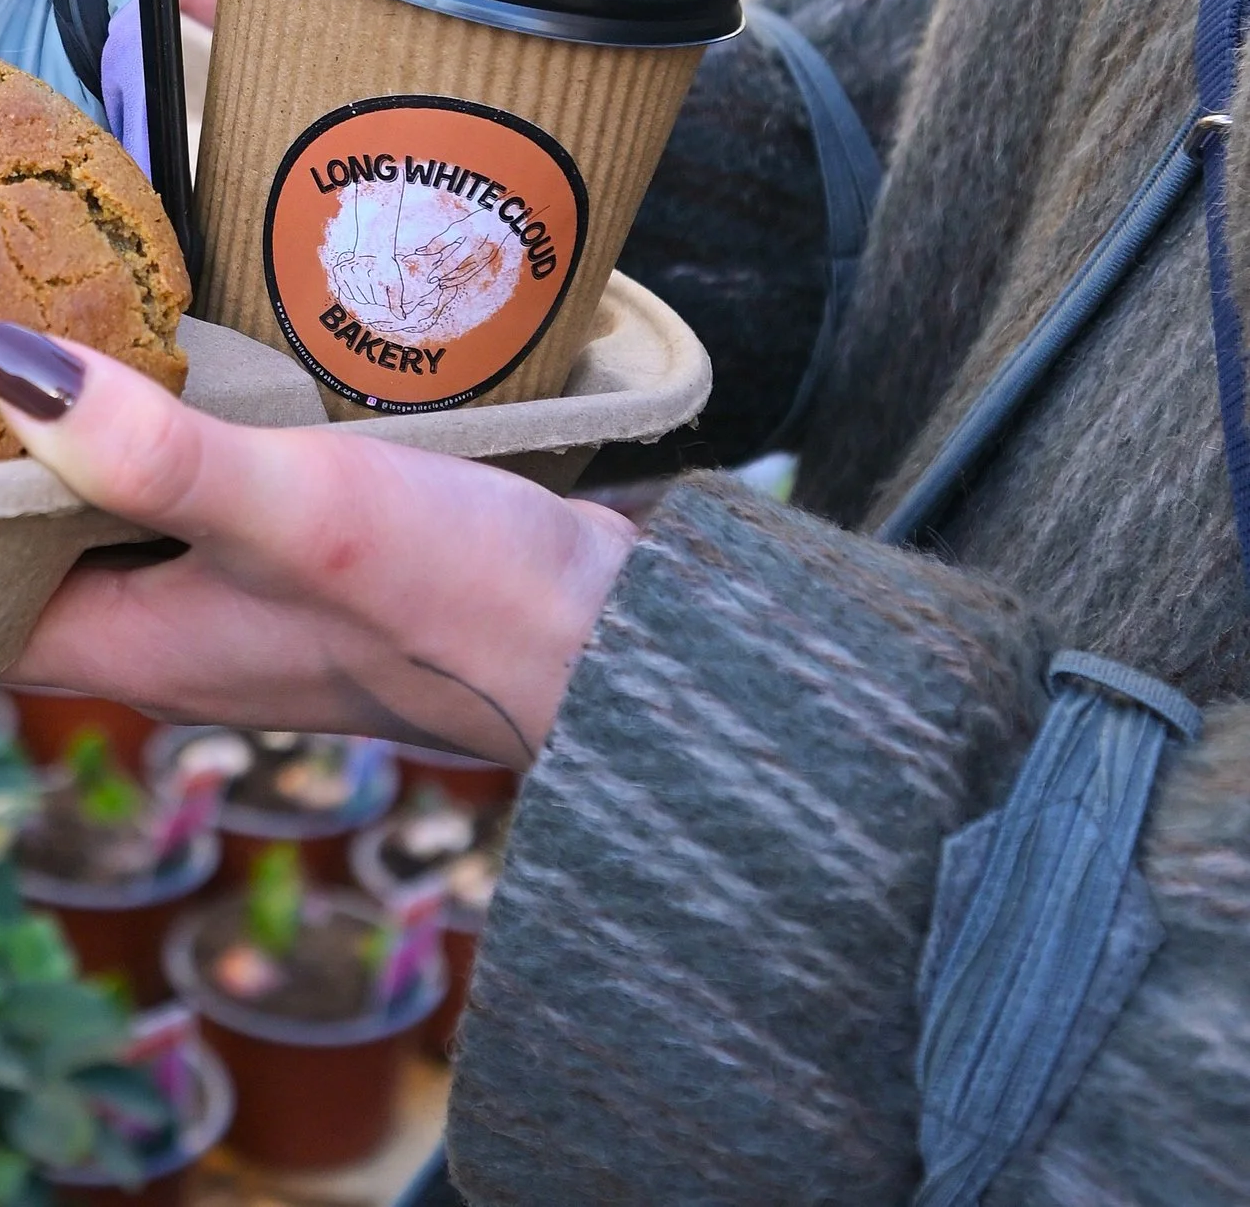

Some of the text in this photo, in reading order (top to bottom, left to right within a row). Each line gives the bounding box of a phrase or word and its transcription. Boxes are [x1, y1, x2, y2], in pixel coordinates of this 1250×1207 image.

[310, 154, 558, 281] LONG WHITE CLOUD
[319, 304, 447, 376] BAKERY
